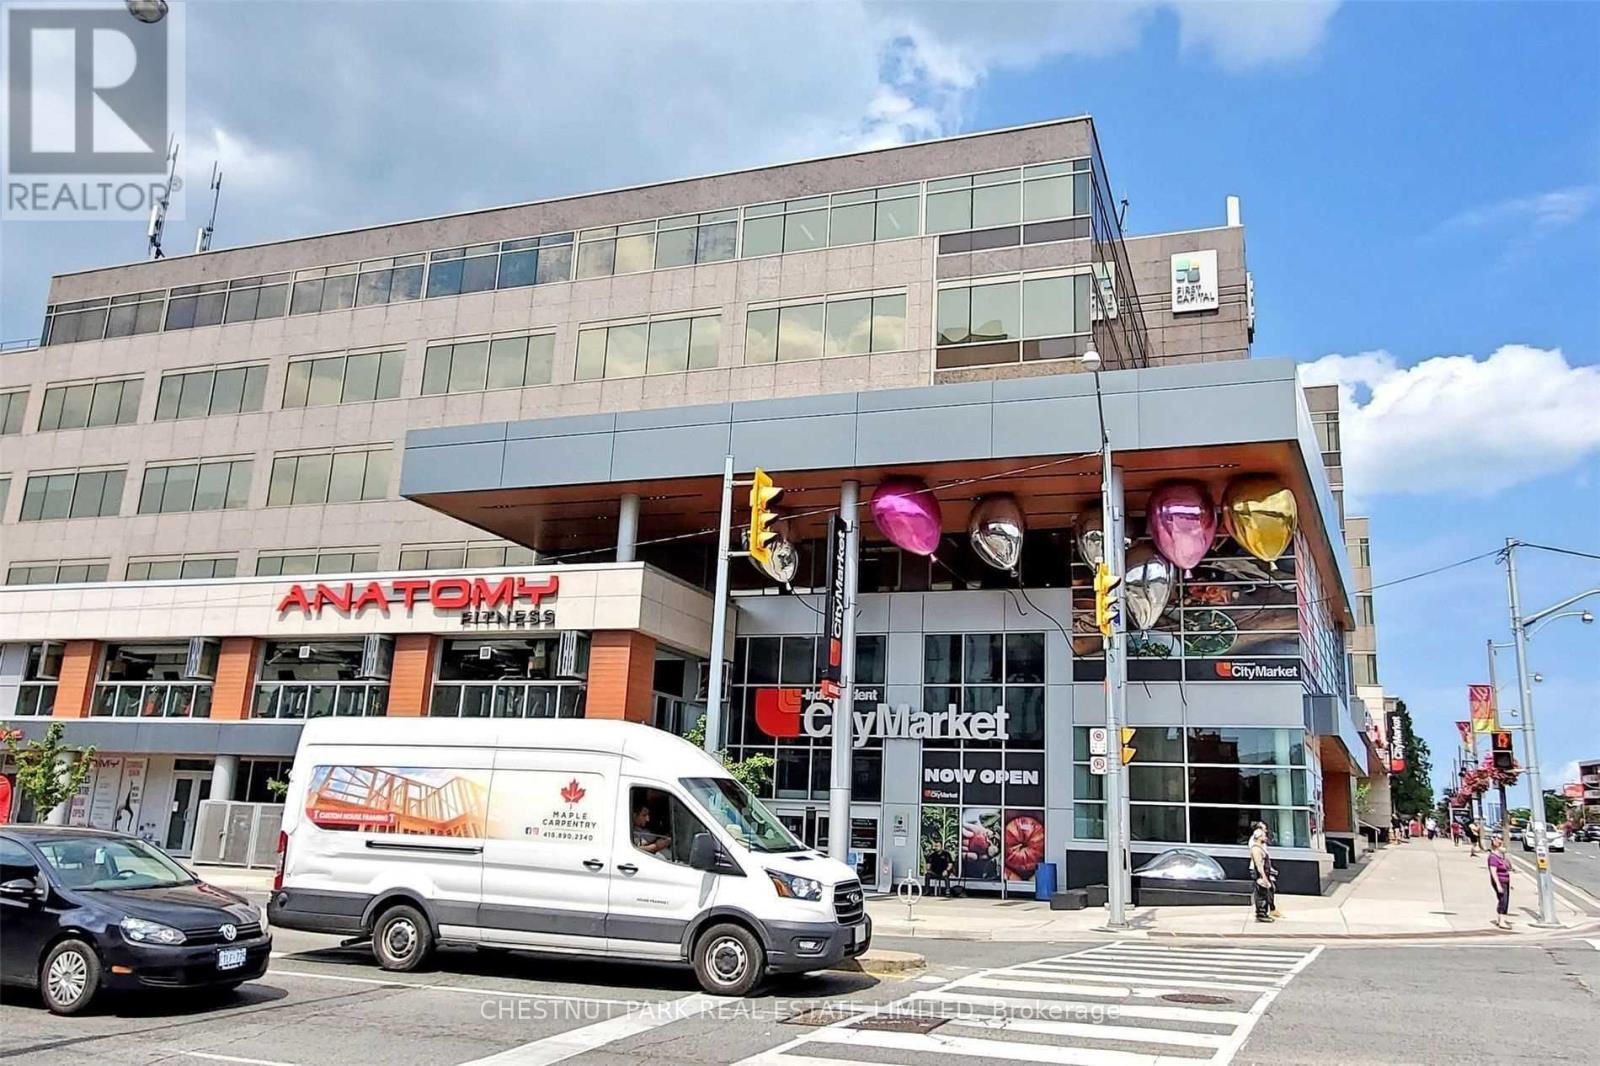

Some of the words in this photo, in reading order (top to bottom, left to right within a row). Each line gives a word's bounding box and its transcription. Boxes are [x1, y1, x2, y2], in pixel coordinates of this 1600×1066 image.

[1176, 284, 1202, 295] FIRST
[1176, 292, 1216, 305] CAPITAL
[834, 529, 847, 639] CityMarket
[276, 575, 560, 612] ANATOMY
[460, 609, 556, 627] FITNESS
[1231, 665, 1299, 680] CityMarket
[803, 702, 1010, 748] CyMarket
[924, 768, 976, 783] NOW
[980, 769, 1039, 785] OPEN
[542, 818, 597, 829] CARPENTRY
[553, 811, 588, 820] MAPLE
